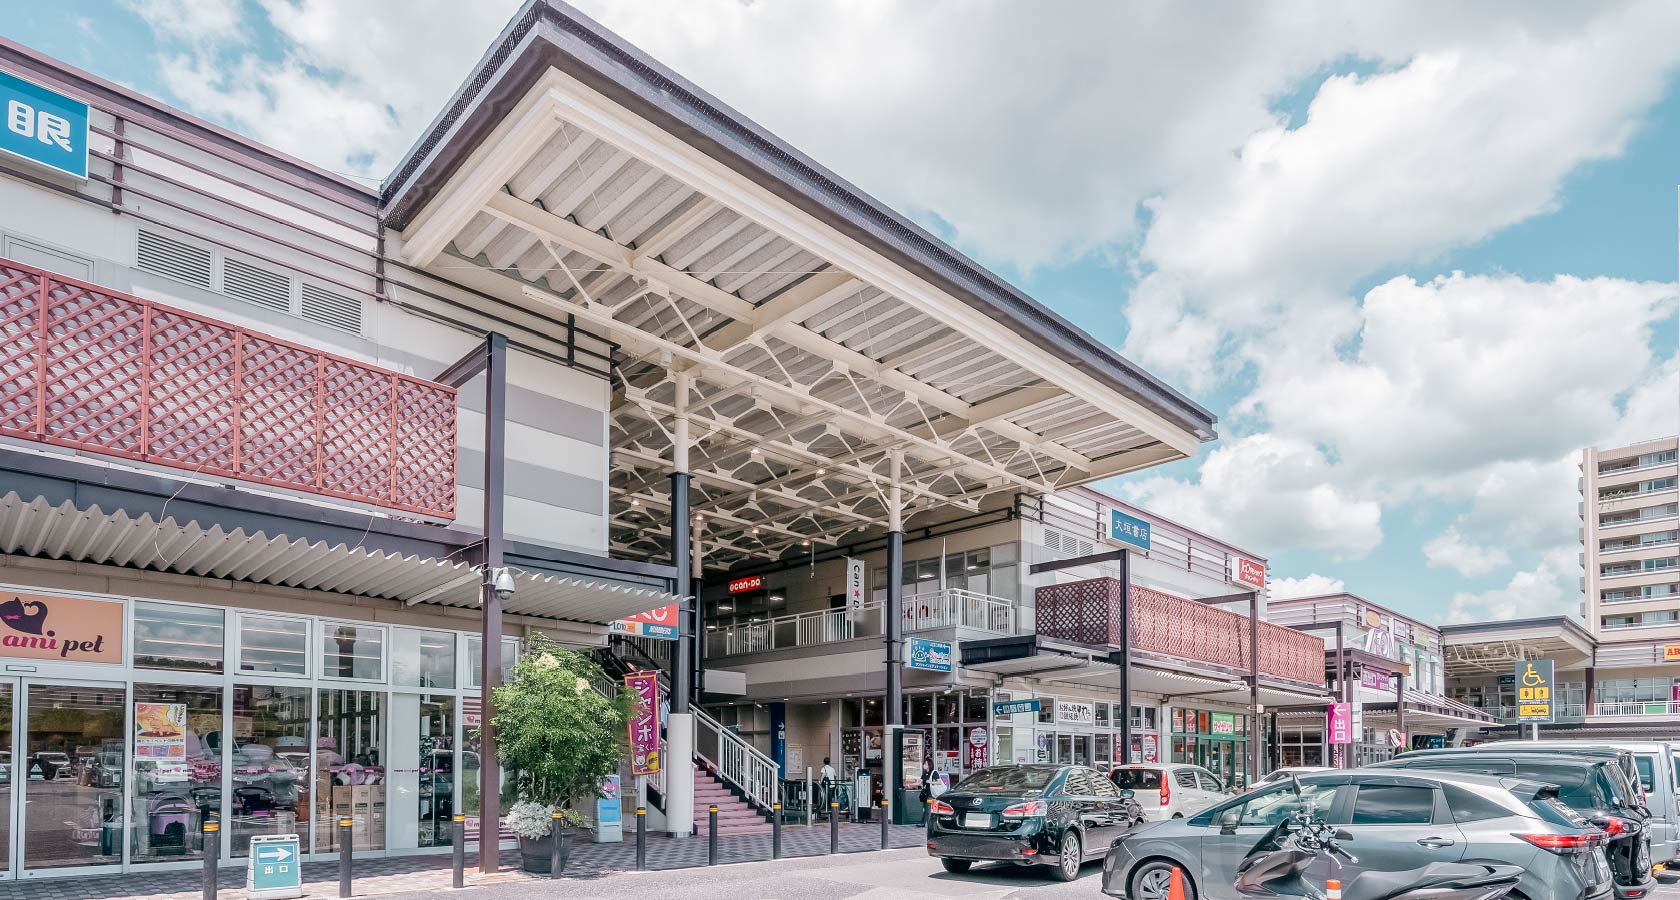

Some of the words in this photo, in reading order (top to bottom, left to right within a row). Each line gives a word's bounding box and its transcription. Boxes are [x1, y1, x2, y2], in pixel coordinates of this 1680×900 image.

[8, 99, 73, 153] 眼
[1115, 519, 1148, 541] 大垣書店
[3, 630, 58, 650] ami
[60, 634, 104, 657] pet
[1334, 718, 1346, 741] 出口
[264, 865, 288, 874] 出口
